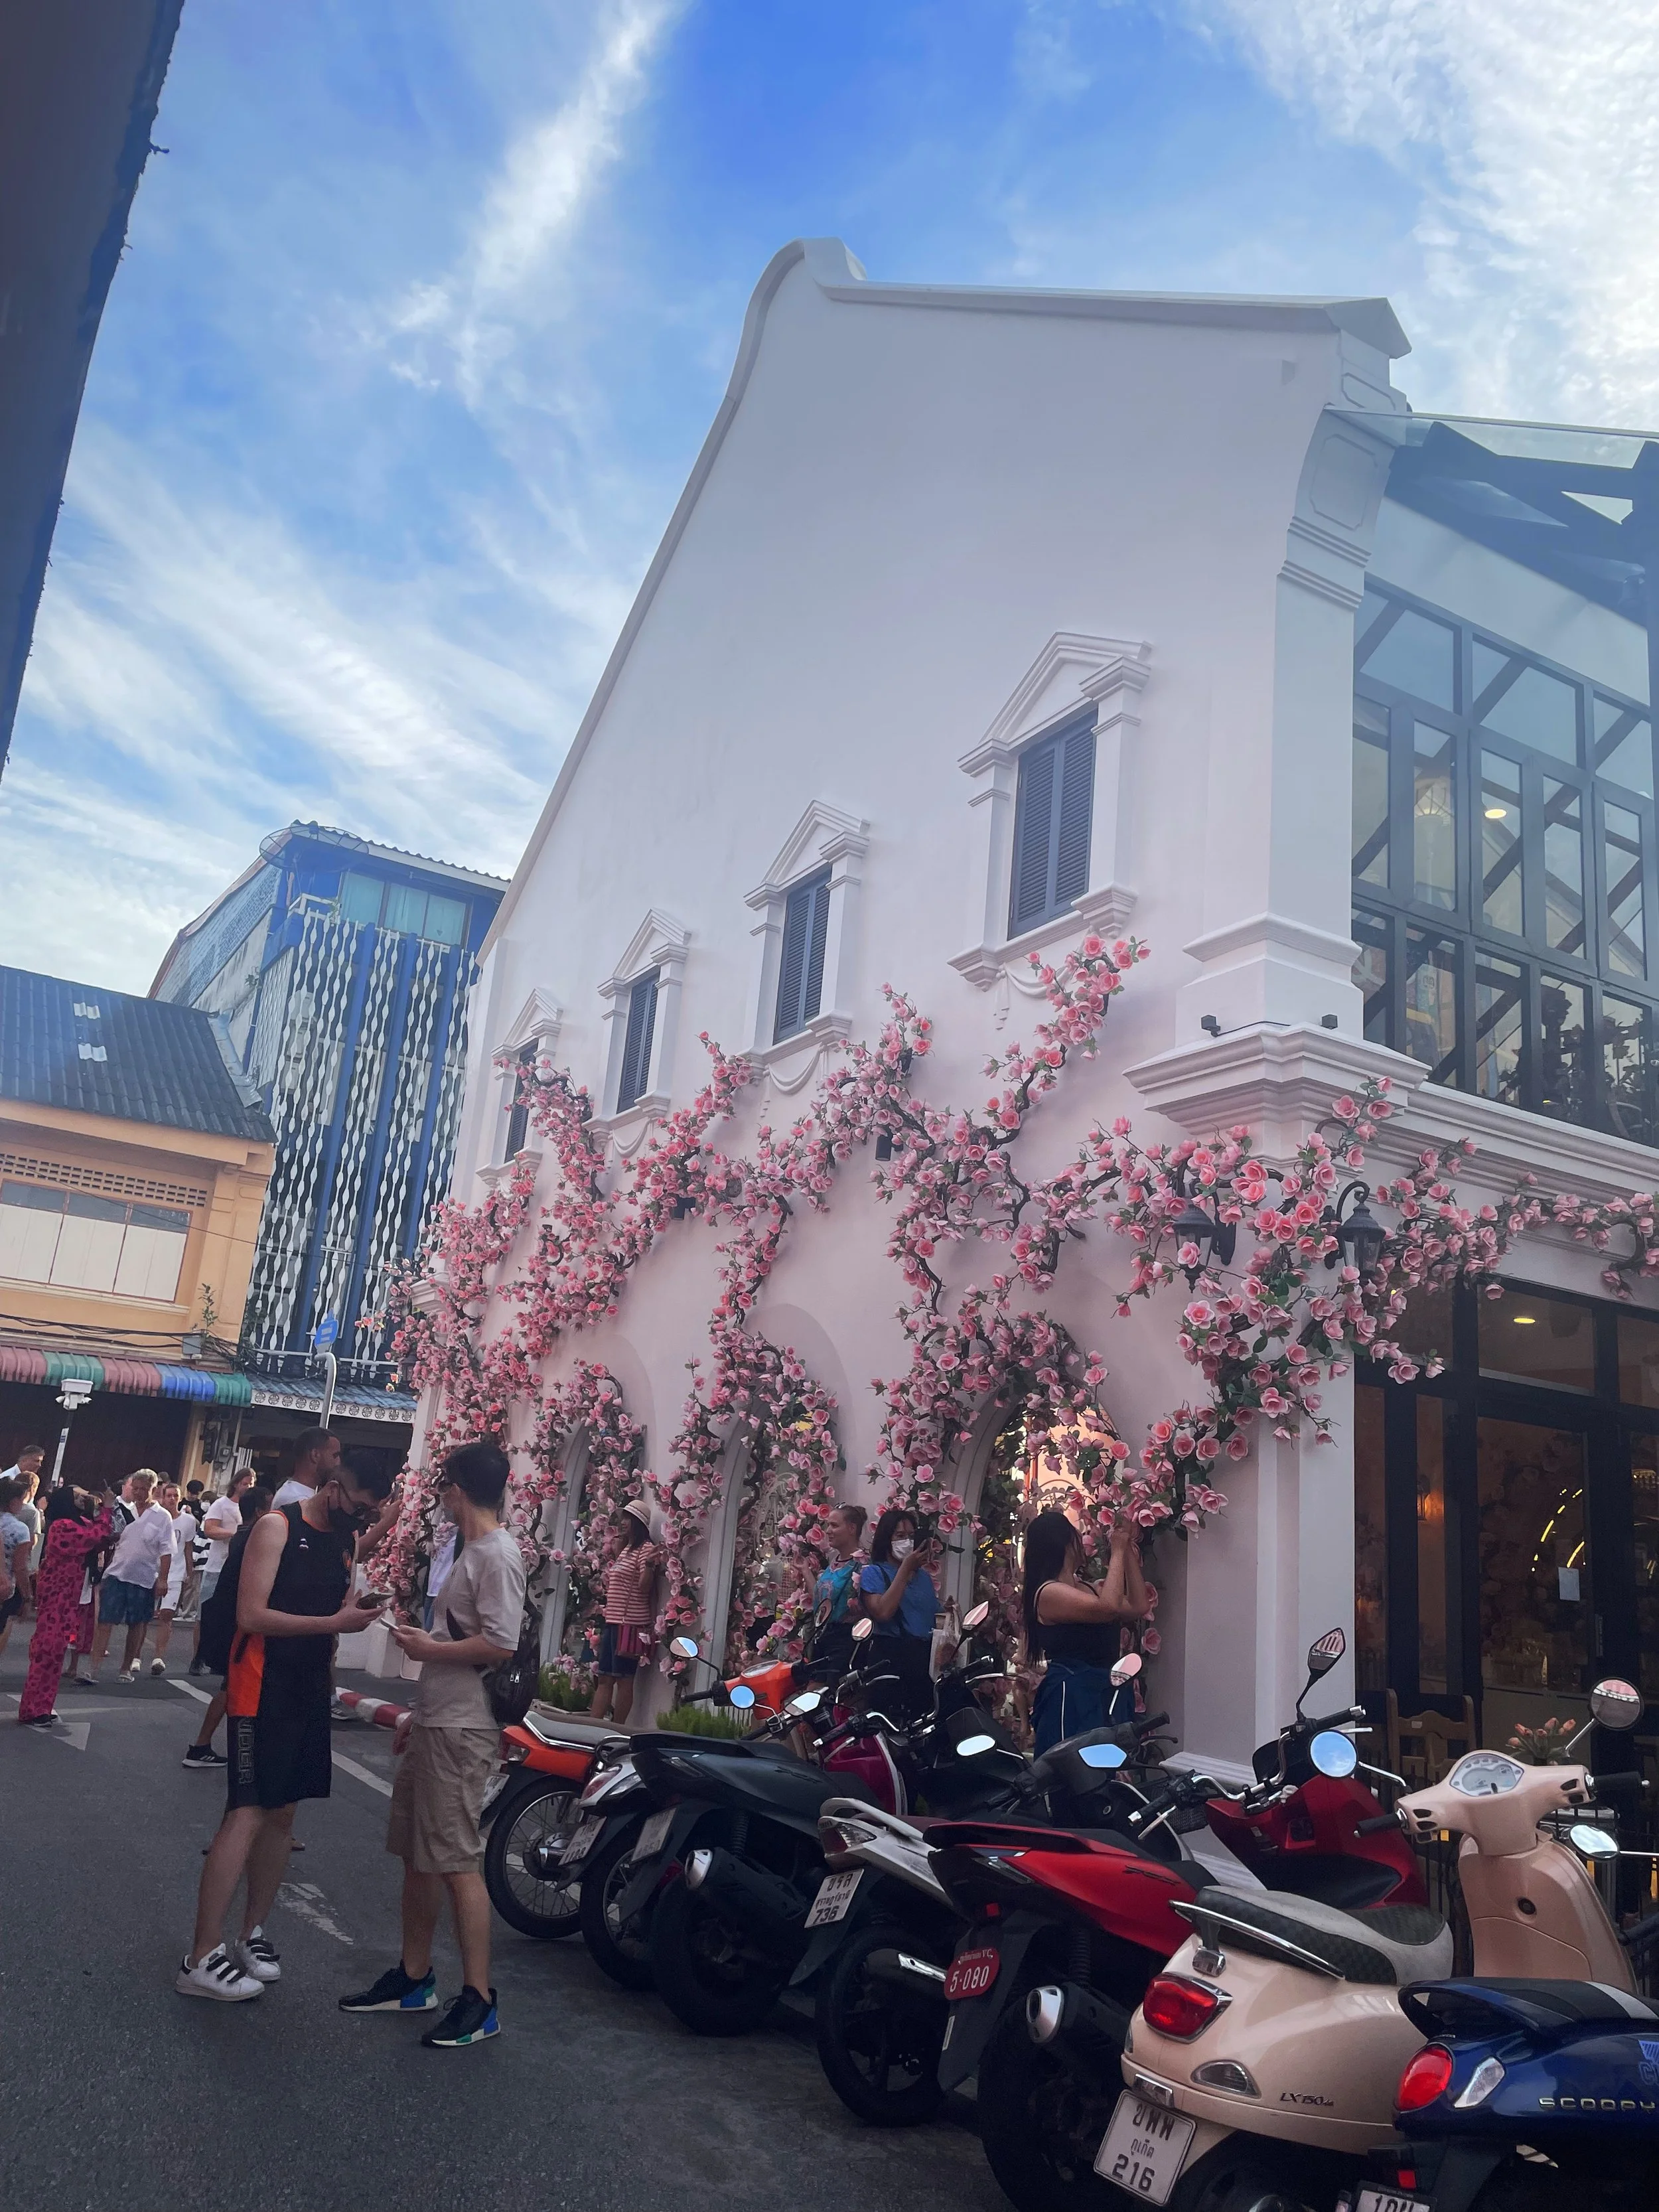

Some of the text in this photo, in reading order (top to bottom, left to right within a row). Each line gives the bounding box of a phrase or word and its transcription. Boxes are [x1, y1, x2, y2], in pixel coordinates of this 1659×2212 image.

[813, 1905, 839, 1924] 736
[1539, 2097, 1656, 2114] SCOOPY
[1112, 2153, 1155, 2192] 216
